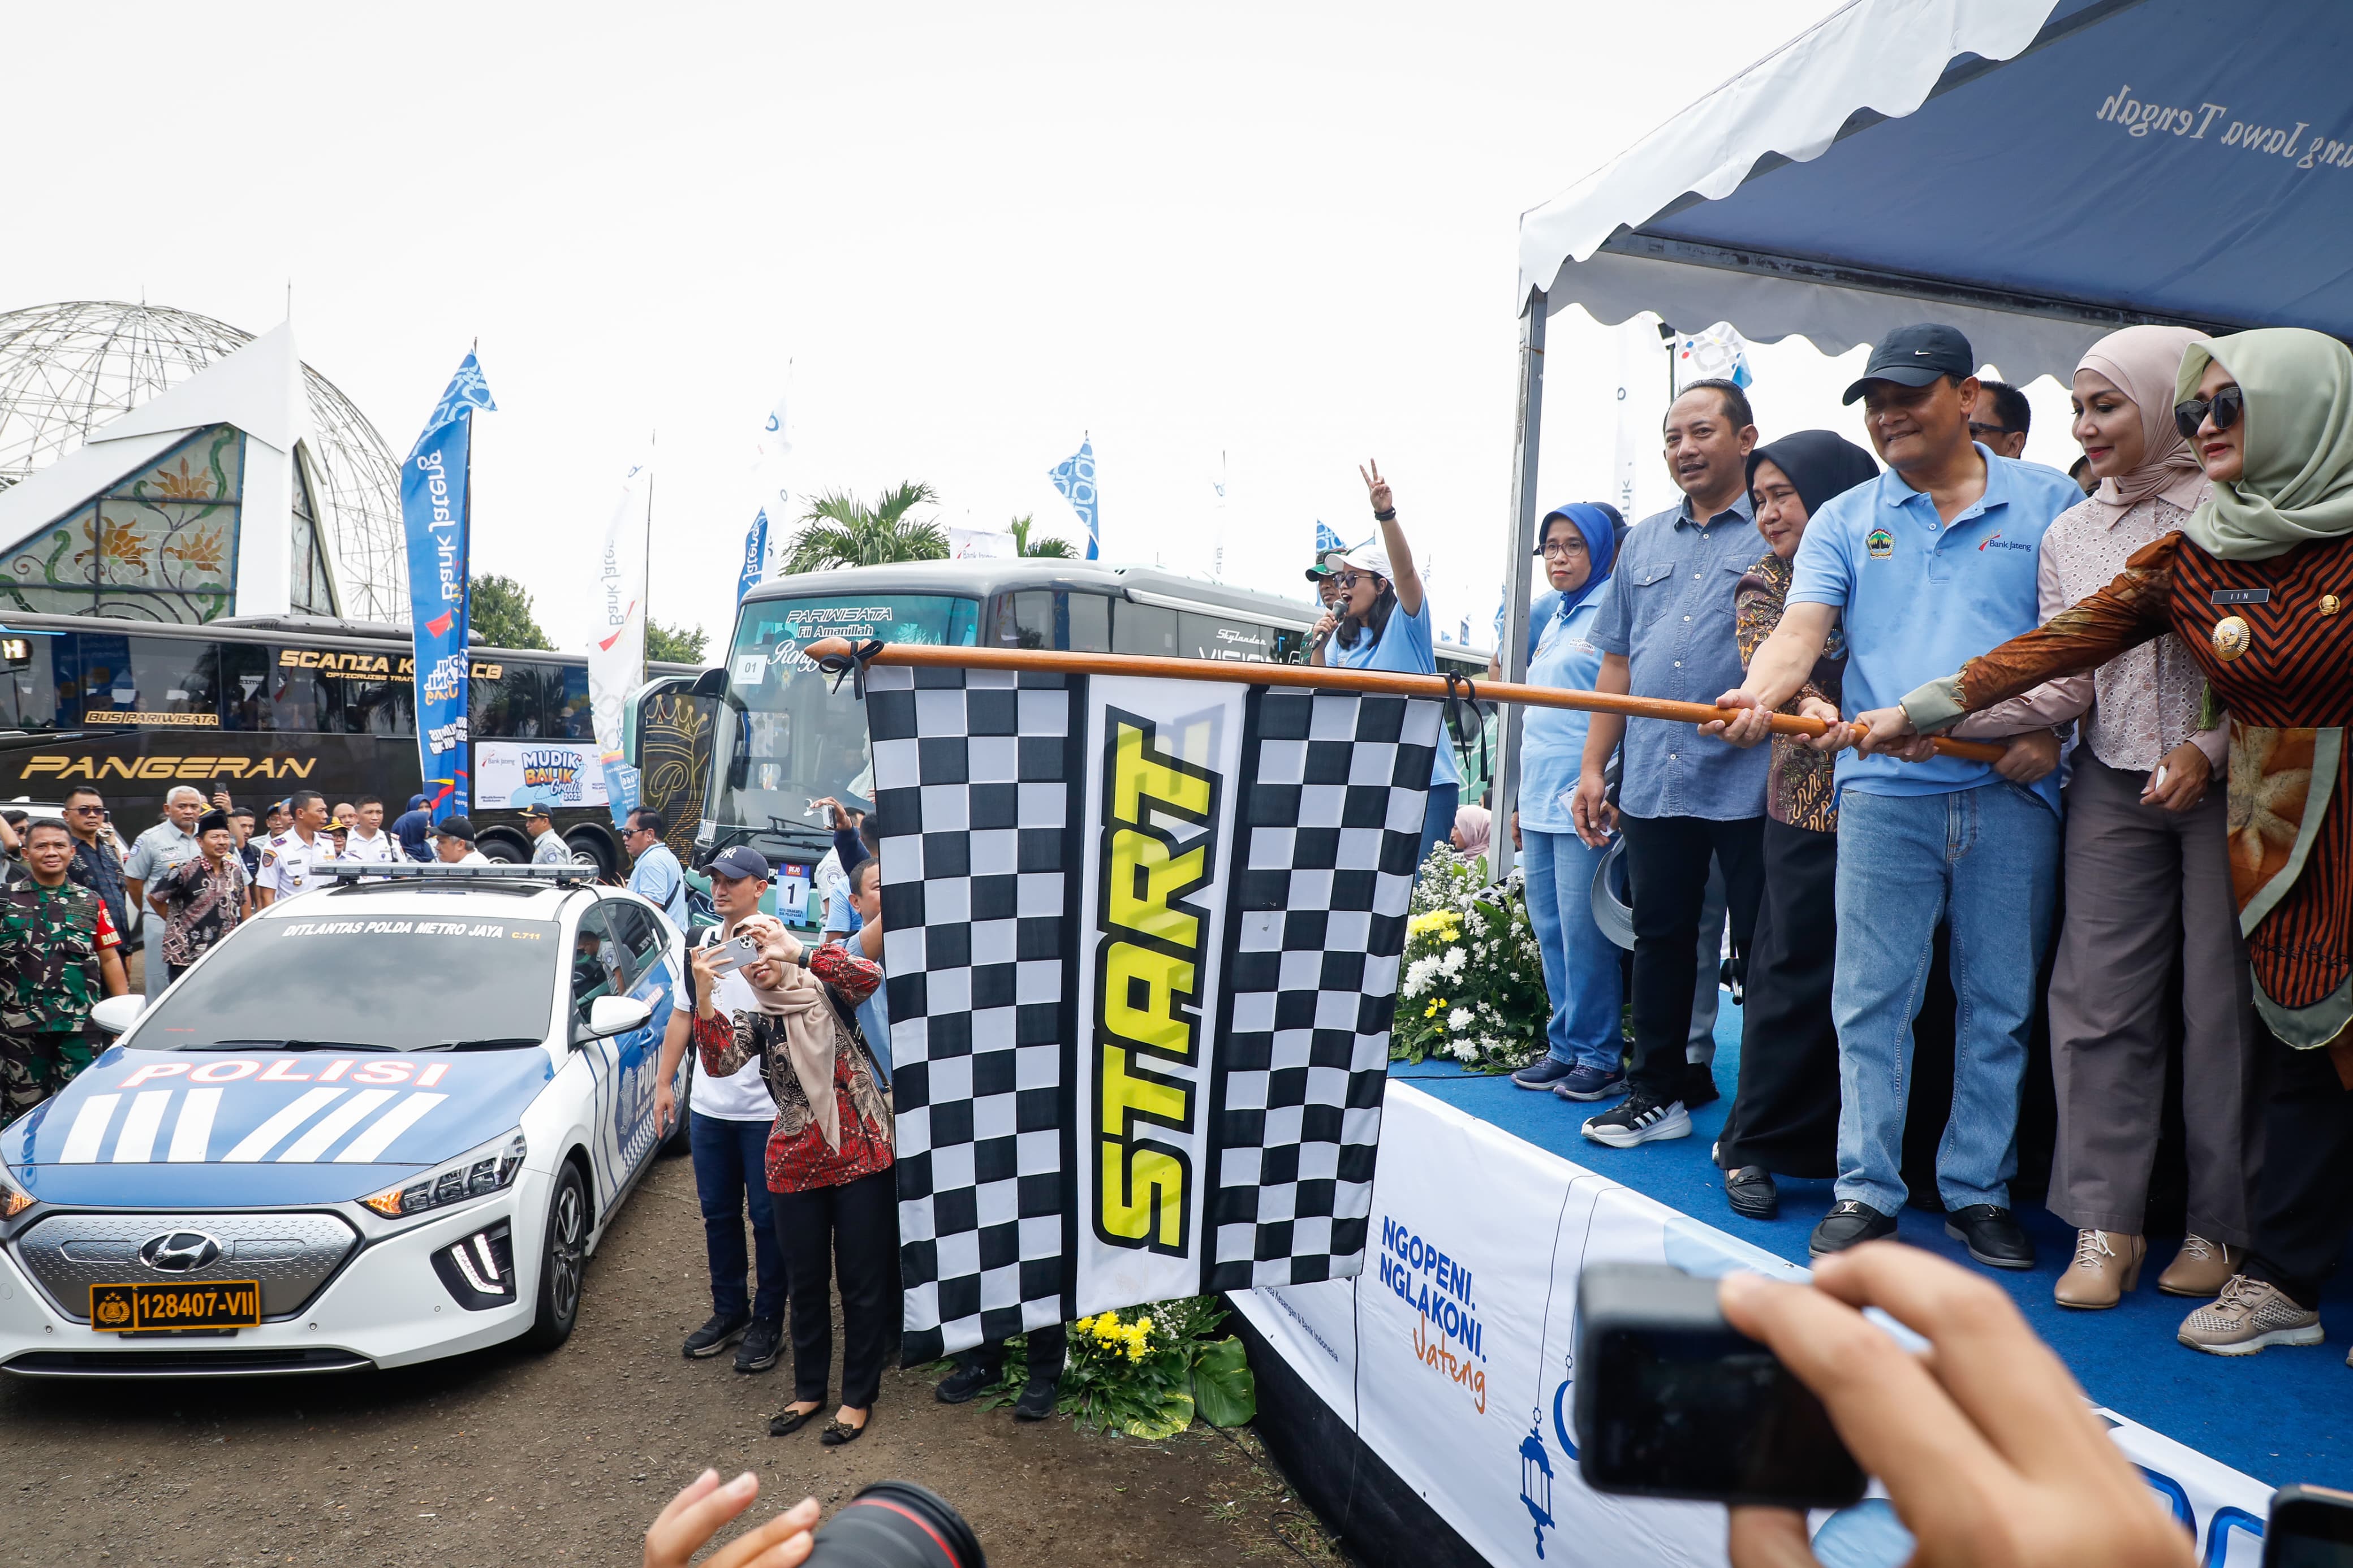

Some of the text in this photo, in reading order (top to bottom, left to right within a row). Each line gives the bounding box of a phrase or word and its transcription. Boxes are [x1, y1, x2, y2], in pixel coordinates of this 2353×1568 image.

[1989, 539, 2032, 552] Bank Jateng
[786, 607, 893, 624] PARIWISATA
[813, 624, 874, 638] Amanillah
[1216, 628, 1266, 646] Skylander
[278, 650, 390, 673] SCANIA
[471, 663, 503, 679] CB
[744, 662, 756, 673] 01
[325, 671, 387, 681] OPTICRUISE
[87, 712, 218, 725] BUS PARIWISATA
[20, 756, 317, 779] PANGERAN
[522, 751, 579, 770] MUDIK
[524, 768, 574, 787] BALIK
[550, 777, 583, 796] Gratis
[563, 792, 582, 801] 2025
[787, 883, 795, 904] 1
[282, 922, 541, 940] DITLANTAS POLDA METRO JAYA C.711
[1092, 703, 1223, 1259] START
[117, 1059, 453, 1088] POLISI
[1382, 1215, 1476, 1311] NGOPENI.
[140, 1291, 254, 1318] 128407-VII
[1380, 1251, 1487, 1363] NGLAKONI.
[1301, 1316, 1313, 1338] Bank
[1314, 1329, 1338, 1362] Indonesia
[1413, 1311, 1485, 1415] Jateng
